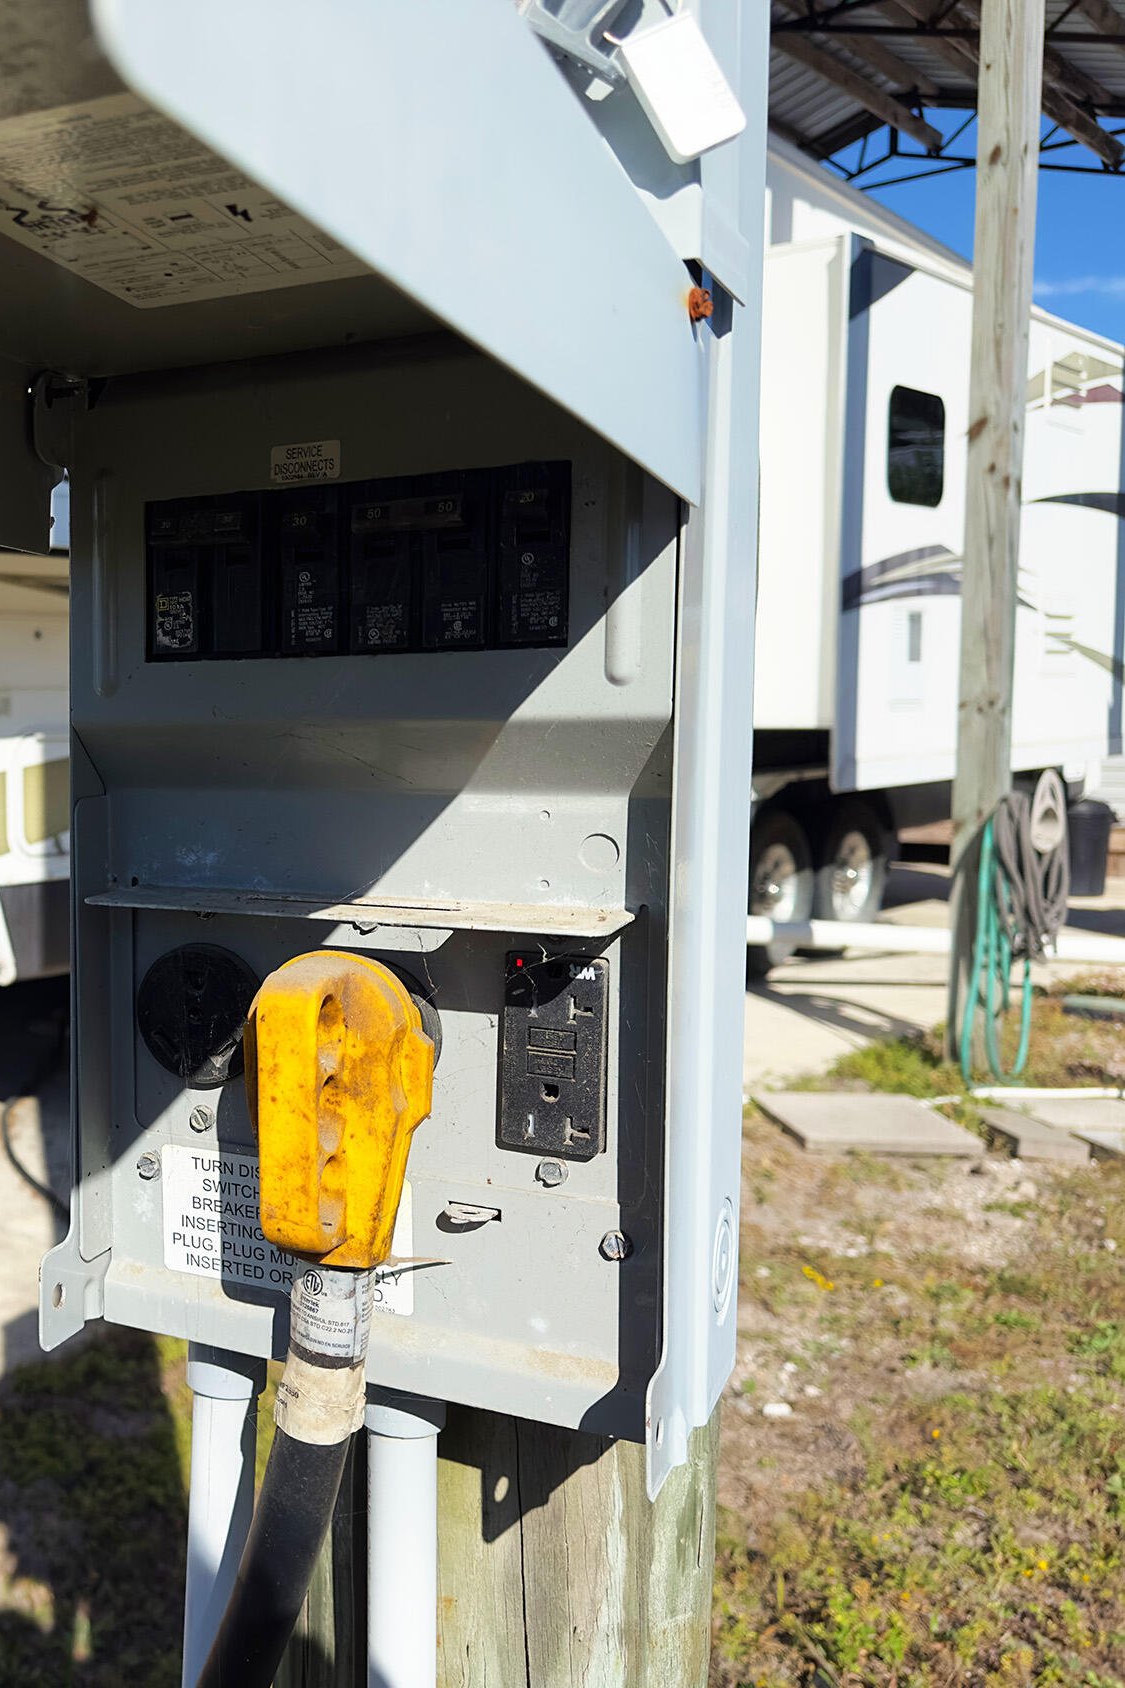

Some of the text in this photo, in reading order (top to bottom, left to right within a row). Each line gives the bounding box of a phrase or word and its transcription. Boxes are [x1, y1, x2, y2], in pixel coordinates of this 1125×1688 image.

[285, 445, 323, 460] SERVICE
[274, 458, 335, 475] DISCONNECTS
[191, 1156, 234, 1176] TURN
[181, 1214, 265, 1241] INSERTING
[172, 1232, 299, 1267] PLUG. PLUG MU
[186, 1252, 265, 1279] INSERTED
[269, 1269, 294, 1286] OR
